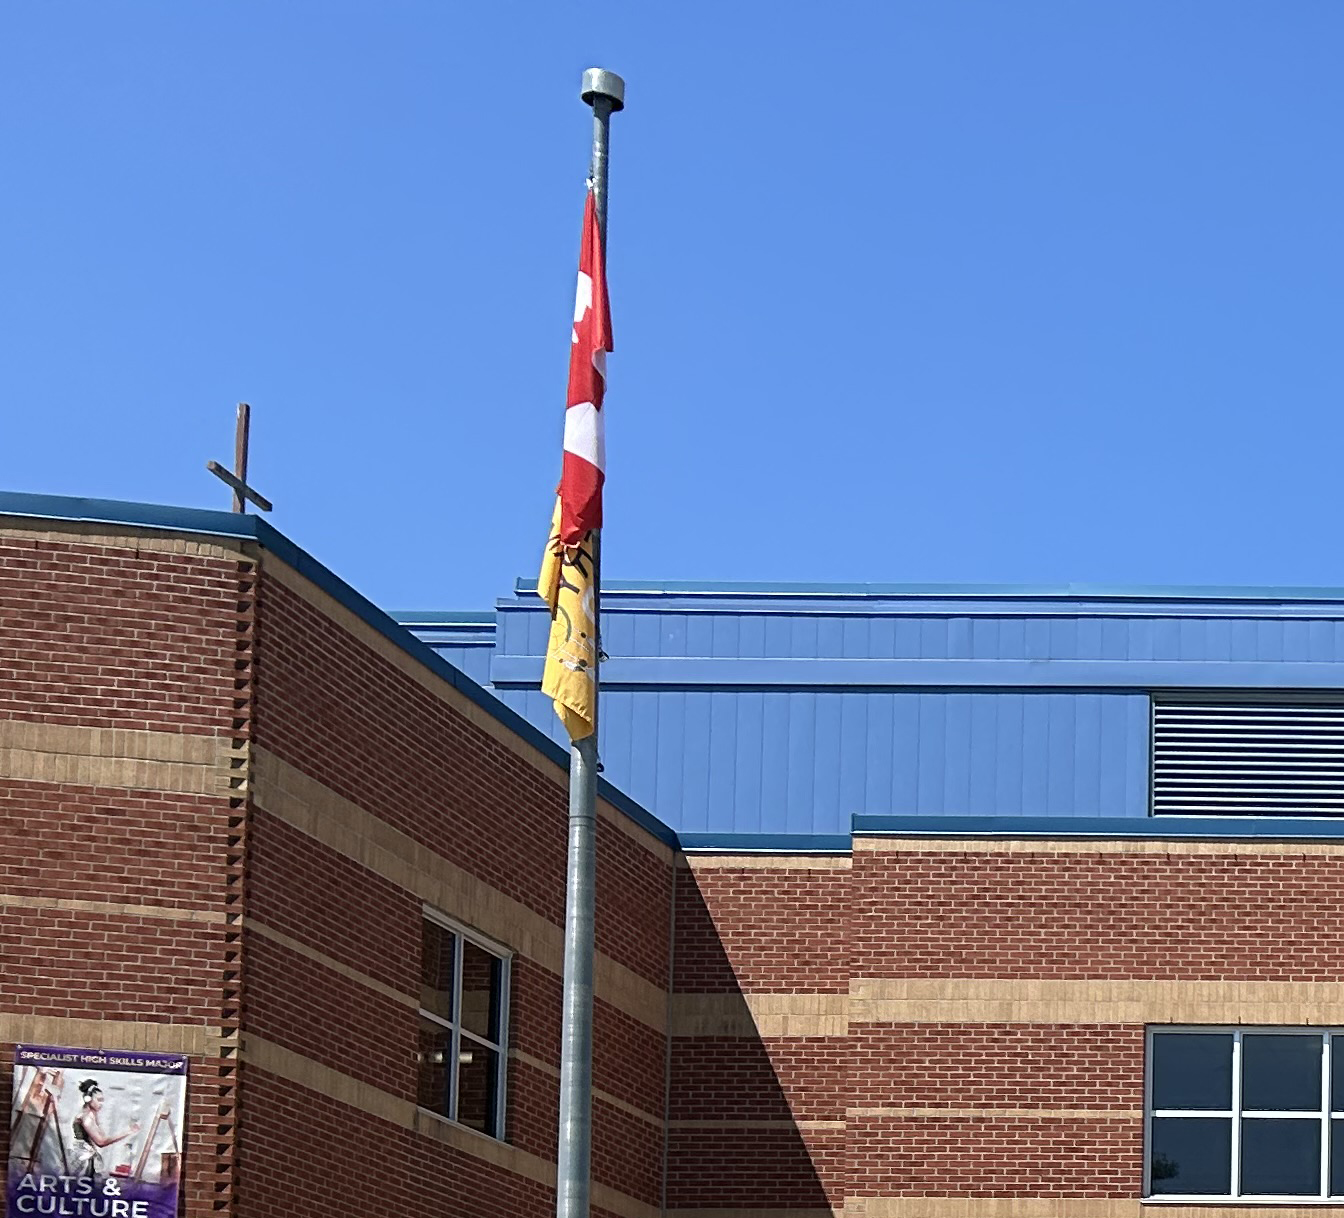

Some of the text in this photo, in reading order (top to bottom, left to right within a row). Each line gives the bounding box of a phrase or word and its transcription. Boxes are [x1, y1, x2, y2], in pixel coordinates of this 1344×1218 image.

[20, 1051, 184, 1070] SPECIALIST HIGH SKILLS MAJOR
[16, 1173, 121, 1197] ARTS &
